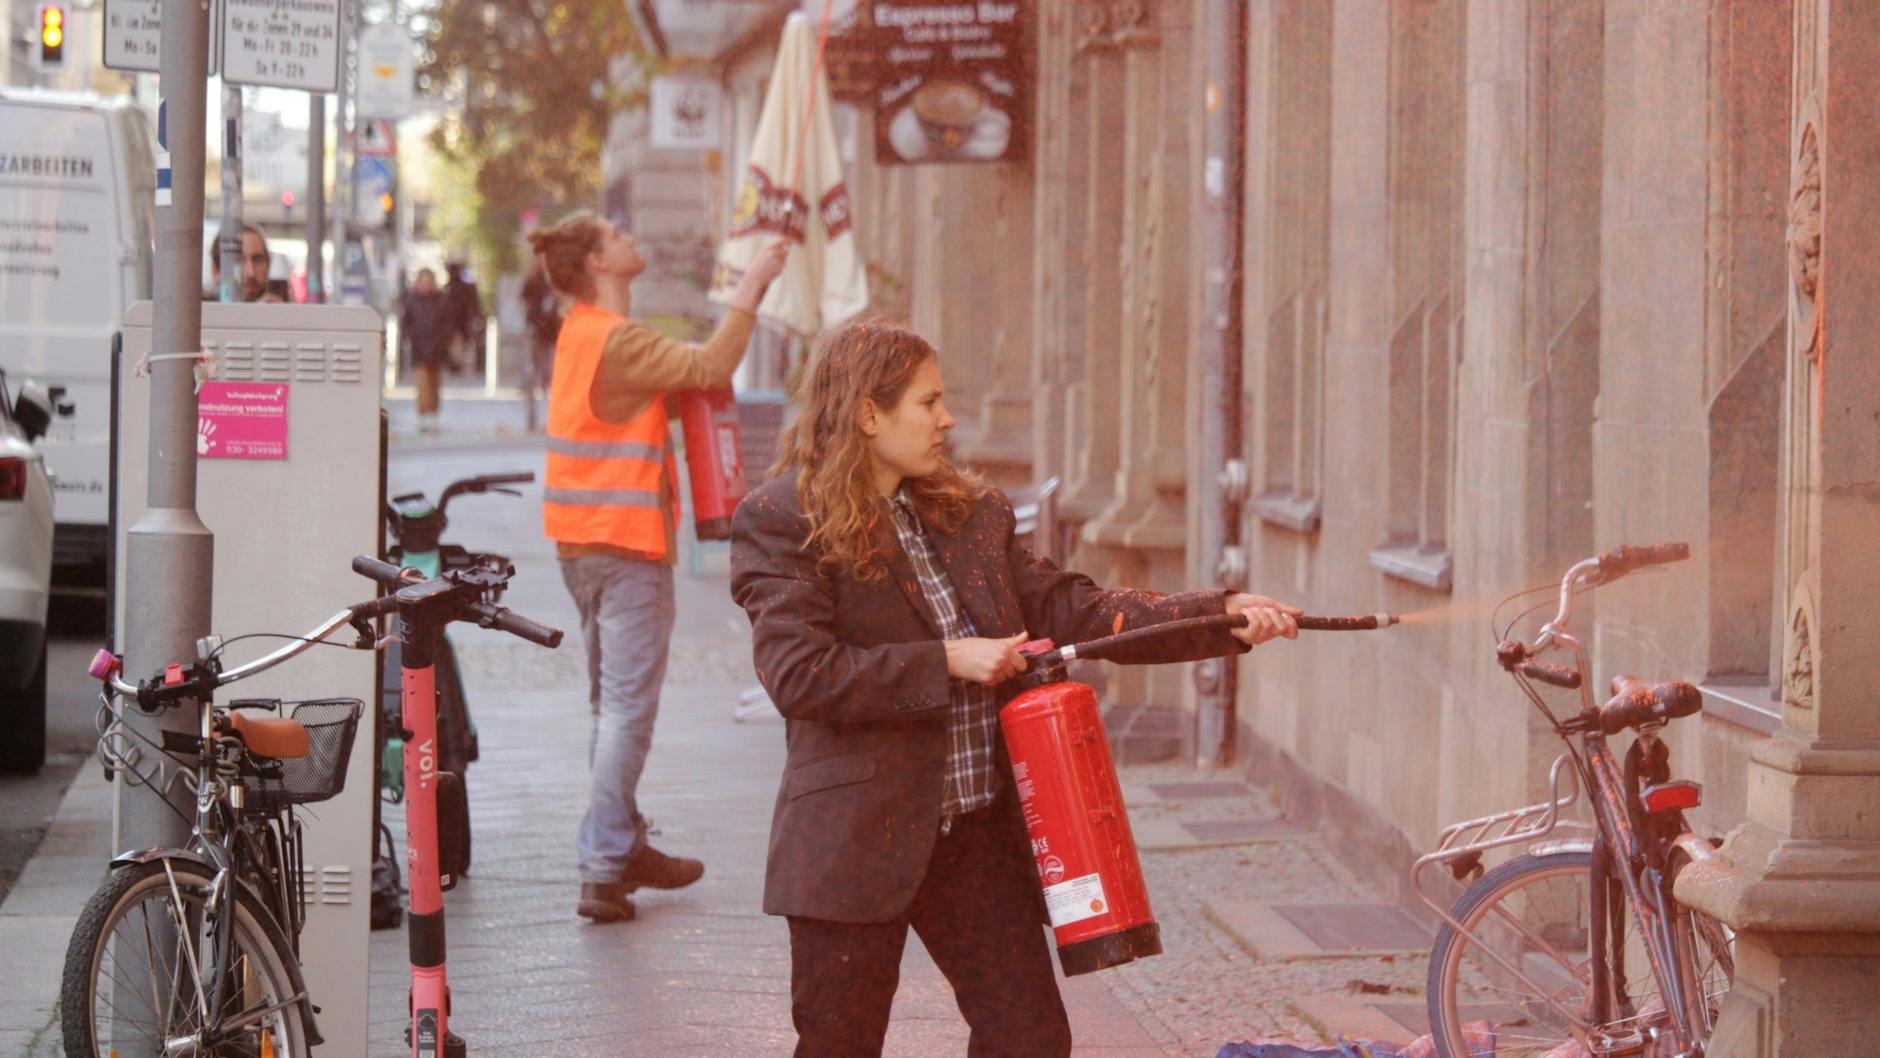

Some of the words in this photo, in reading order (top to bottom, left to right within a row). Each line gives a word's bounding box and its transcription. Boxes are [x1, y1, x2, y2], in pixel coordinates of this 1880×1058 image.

[874, 4, 976, 27] Espresso
[977, 2, 1017, 23] Bar
[245, 405, 284, 413] verboten!
